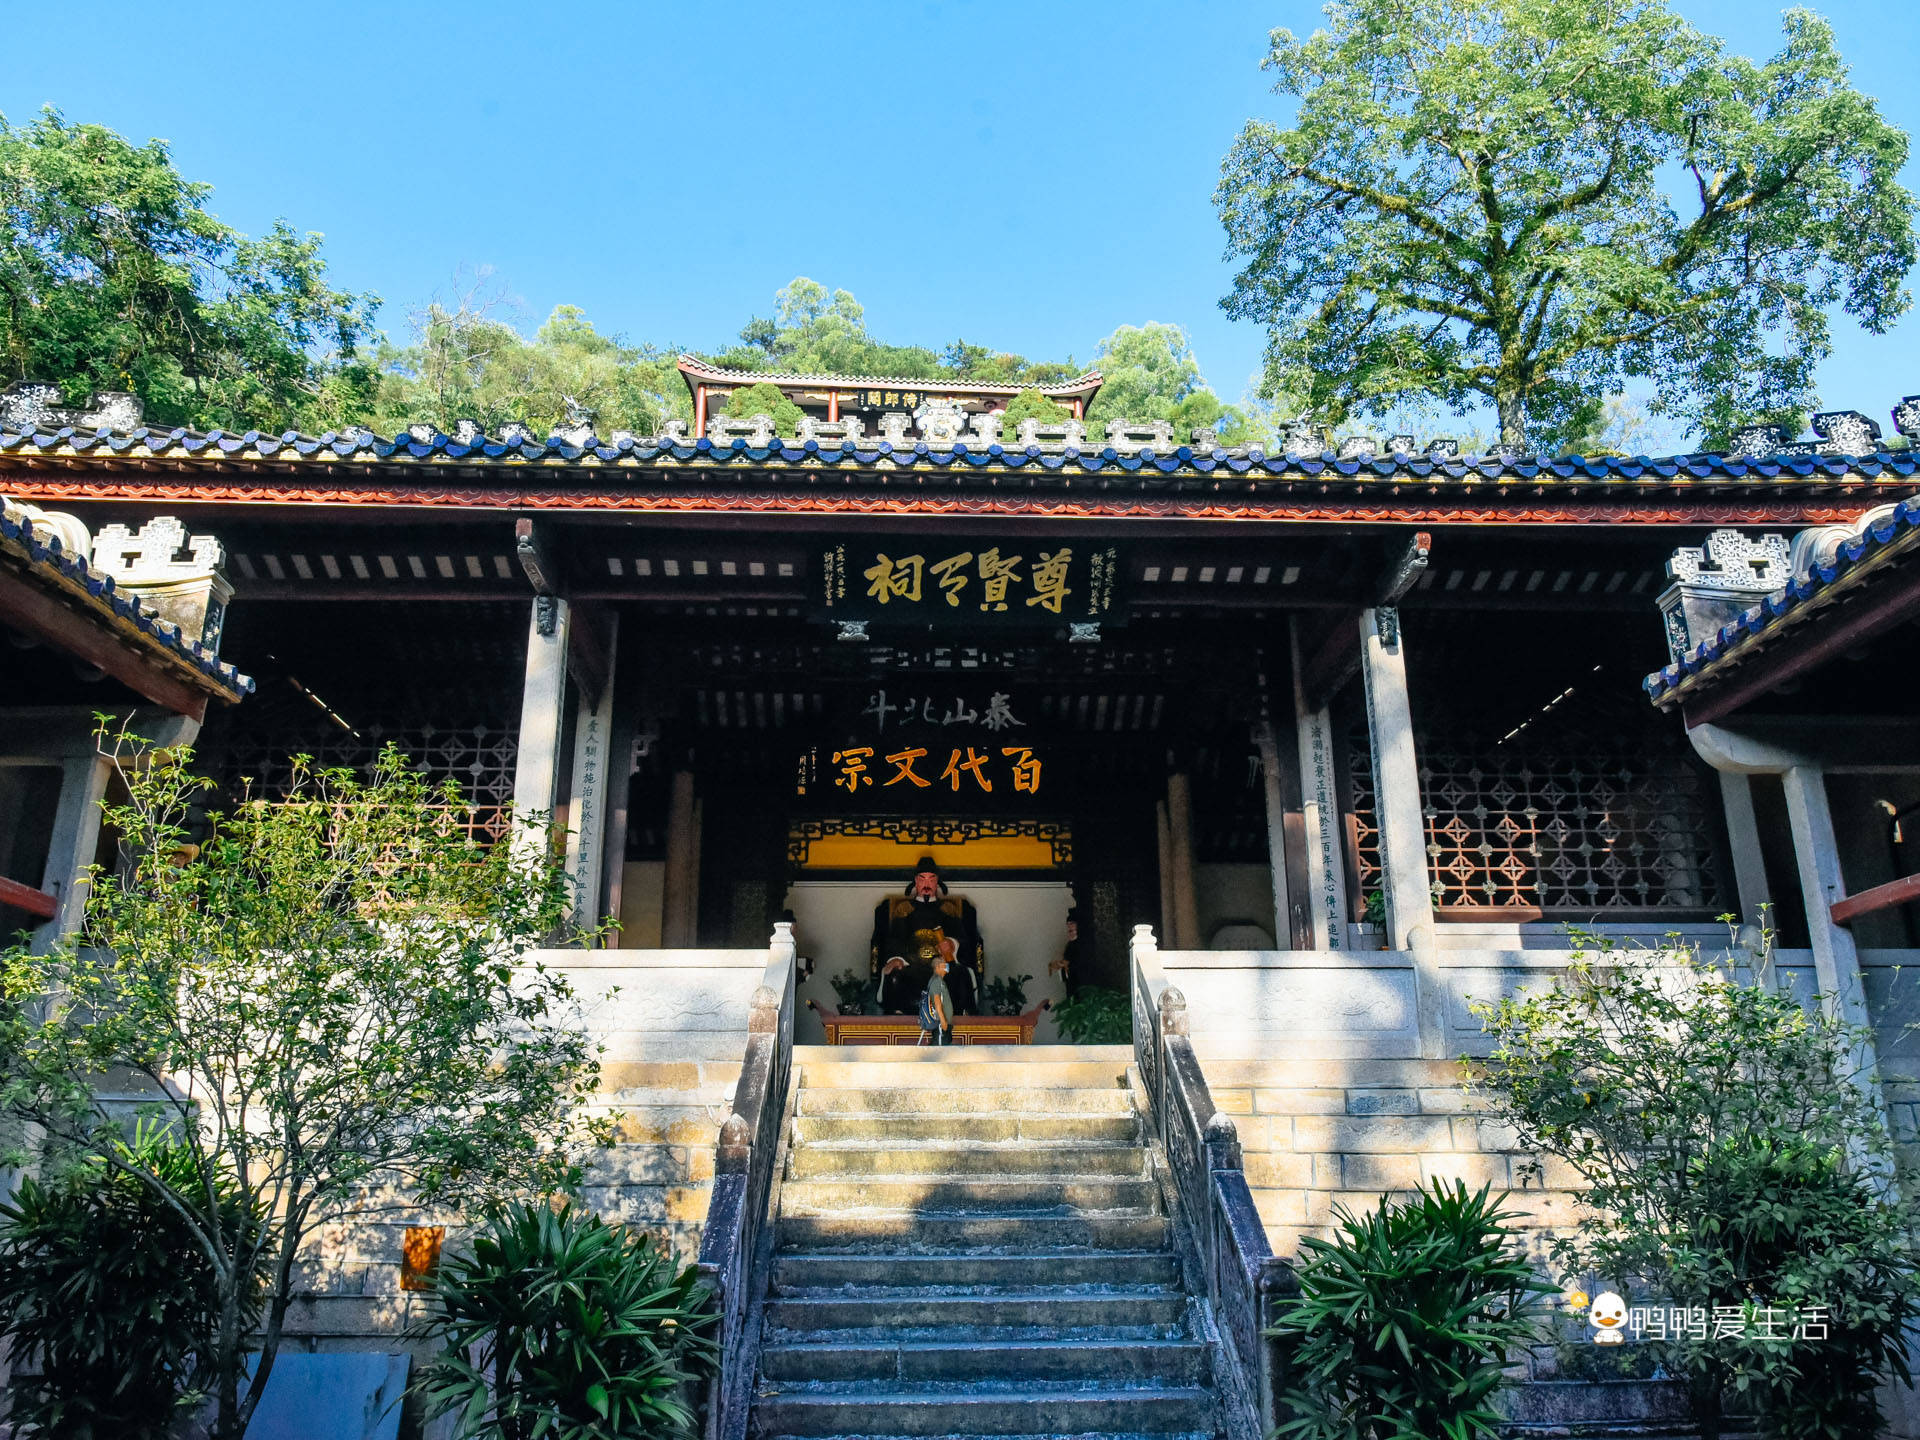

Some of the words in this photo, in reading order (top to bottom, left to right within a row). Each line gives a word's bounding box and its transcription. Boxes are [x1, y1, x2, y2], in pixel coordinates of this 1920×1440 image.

[867, 390, 918, 409] 侍郎閣
[862, 688, 1027, 735] 泰山北斗
[831, 746, 1043, 795] 百代文宗
